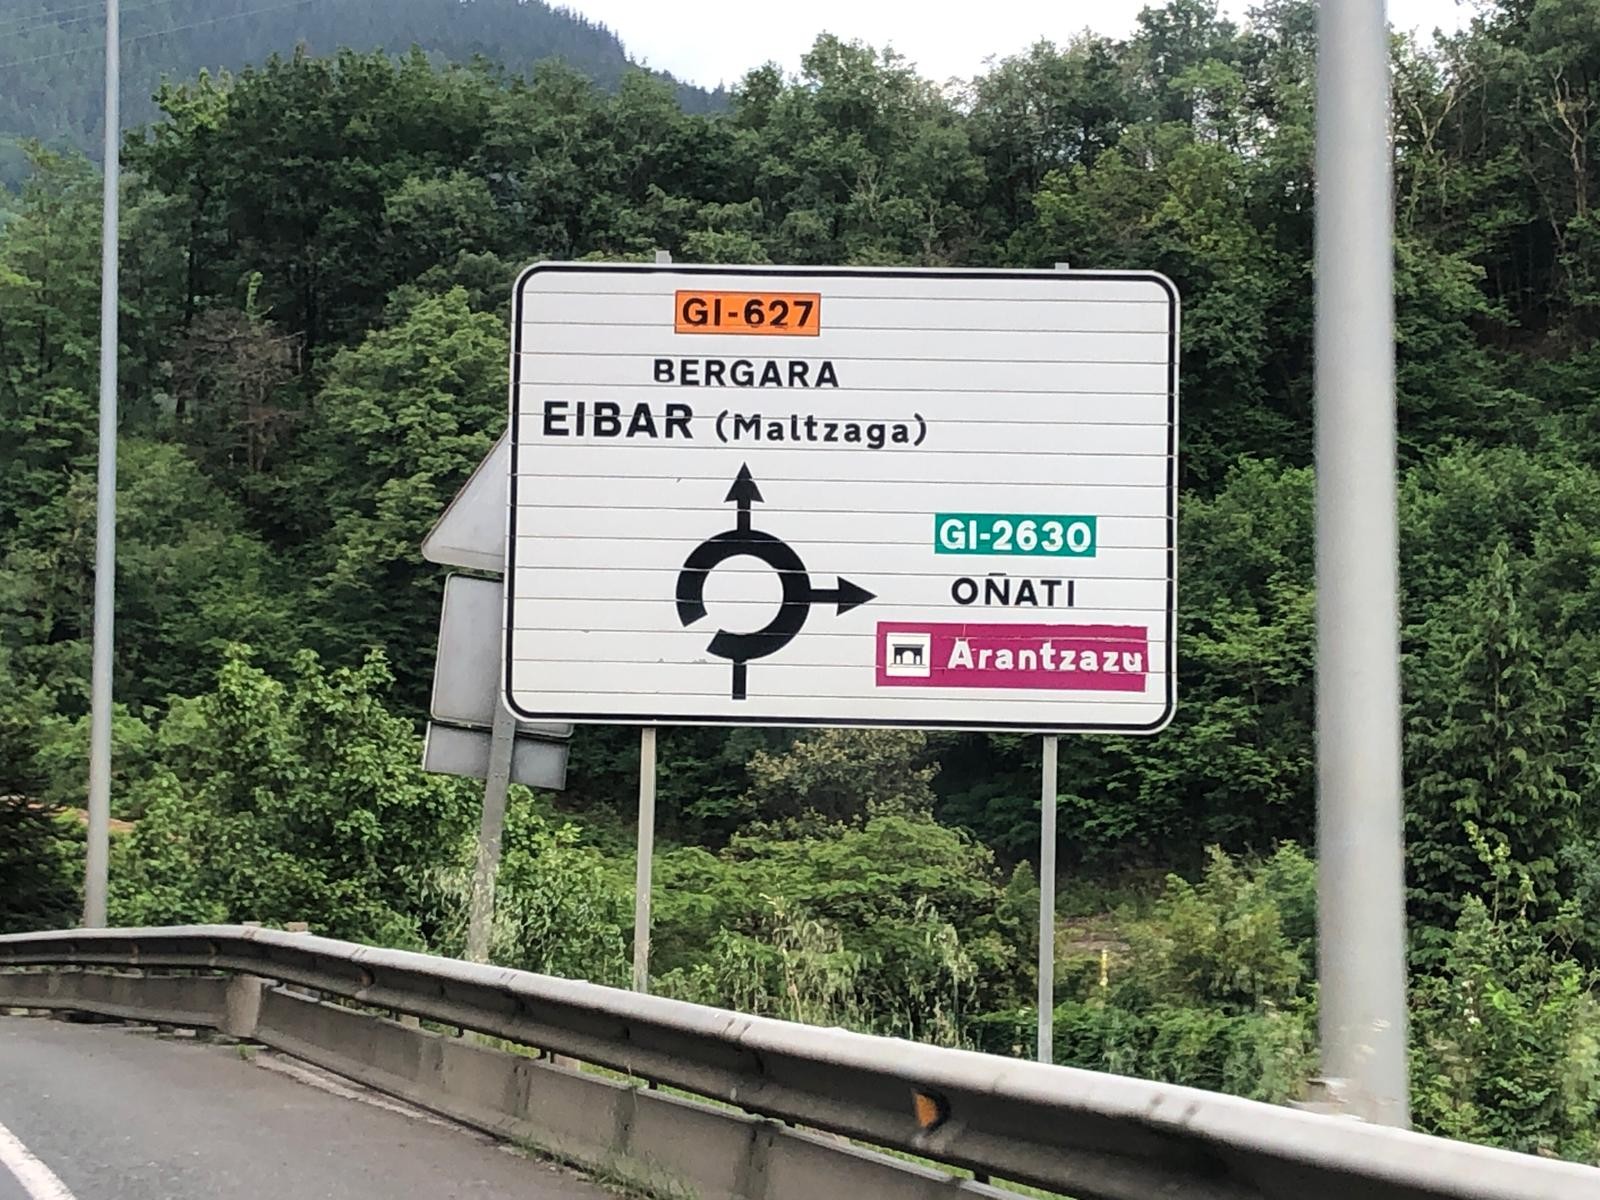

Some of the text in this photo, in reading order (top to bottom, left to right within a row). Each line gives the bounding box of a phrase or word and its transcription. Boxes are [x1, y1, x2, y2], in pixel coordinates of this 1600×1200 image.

[682, 297, 815, 329] GI-627
[653, 358, 840, 388] BERGARA
[542, 400, 928, 449] EIBAR (Maltzaga)
[939, 518, 1092, 553] GI-2630
[950, 572, 1075, 607] OÑATI
[947, 637, 1143, 673] Arantzazu
